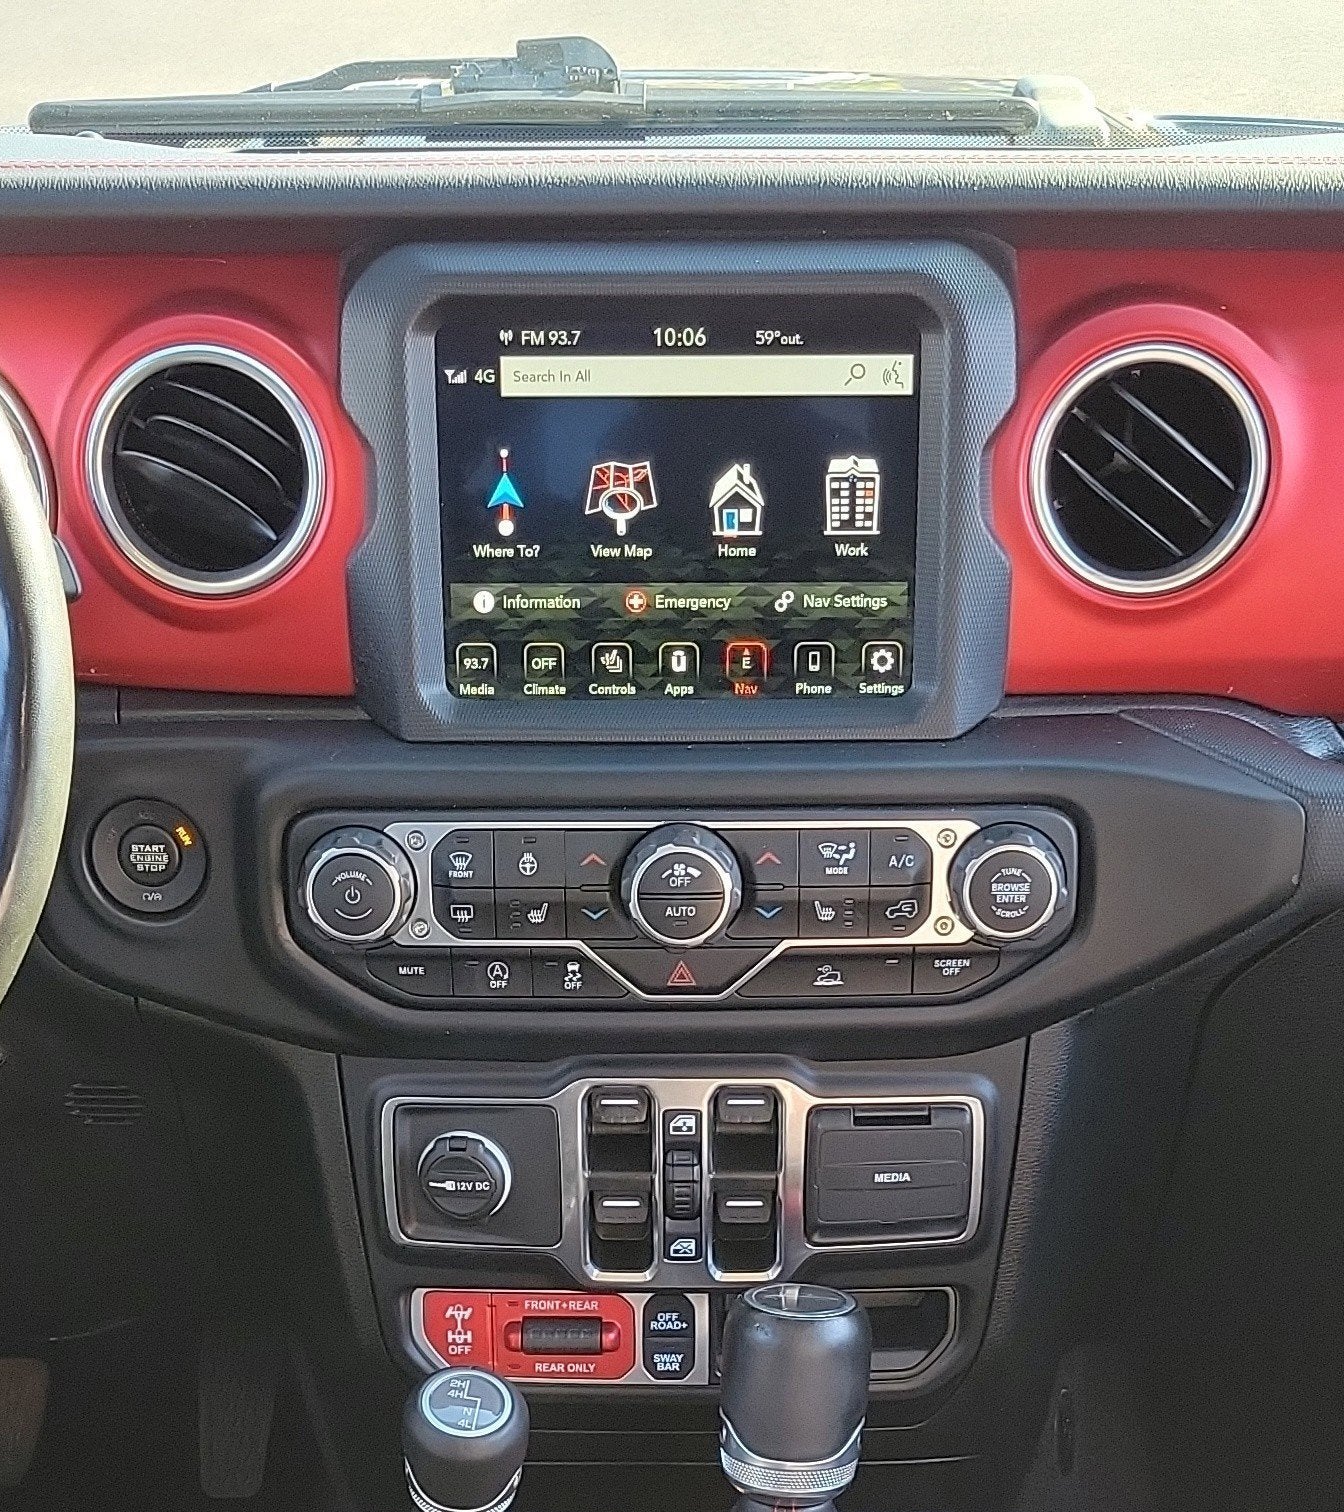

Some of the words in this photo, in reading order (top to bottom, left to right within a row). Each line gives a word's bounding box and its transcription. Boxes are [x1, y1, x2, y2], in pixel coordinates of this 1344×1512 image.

[521, 331, 545, 345] FM
[549, 330, 581, 346] 93.7
[653, 327, 707, 347] 10:06
[474, 369, 495, 384] 4G
[513, 370, 555, 382] Search
[559, 370, 570, 383] In
[575, 370, 591, 383] All
[472, 544, 515, 558] Where
[517, 544, 541, 558] To?
[590, 544, 621, 558] View
[624, 544, 653, 561] Map
[718, 544, 757, 557] Home
[834, 543, 869, 557] Work
[503, 594, 581, 609] Information
[655, 595, 732, 611] Emergency
[803, 595, 830, 608] Nav
[834, 594, 888, 611] Settings
[463, 657, 489, 670] 93.7
[531, 657, 557, 670] OFF
[459, 683, 495, 696] Media
[523, 683, 567, 696] Climate
[588, 683, 637, 696] Controls
[664, 683, 695, 696] Apps
[734, 683, 758, 695] Nav
[795, 683, 832, 695] Phone
[858, 682, 905, 697] Settings
[131, 844, 166, 853] START
[129, 854, 169, 862] ENGINE
[888, 854, 915, 869] A/C
[136, 864, 166, 872] STOP
[825, 866, 849, 875] MODE
[1000, 867, 1023, 877] TUNE
[336, 870, 368, 883] VOLUME
[448, 870, 474, 879] FRONT
[669, 876, 692, 887] OFF
[991, 882, 1031, 892] BROWSE
[996, 894, 1027, 903] ENTER
[664, 906, 696, 917] AUTO
[995, 907, 1027, 918] SCROLL
[933, 958, 970, 968] SCREEN
[398, 966, 426, 975] MUTE
[942, 967, 961, 976] OFF
[489, 980, 508, 989] OFF
[563, 981, 583, 990] OFF
[873, 1172, 911, 1183] MEDIA
[457, 1181, 473, 1191] 12V
[475, 1181, 491, 1191] DC
[524, 1299, 599, 1311] FRONT+REAR
[657, 1312, 679, 1322] OFF
[650, 1321, 689, 1331] ROAD+
[447, 1345, 472, 1355] OFF
[653, 1353, 684, 1363] SWAY
[534, 1362, 567, 1373] REAR
[569, 1362, 596, 1373] ONLY
[656, 1362, 680, 1372] BAR
[449, 1379, 467, 1389] 2H
[446, 1389, 464, 1399] 4H
[462, 1407, 473, 1416] N
[457, 1418, 472, 1429] 4L
